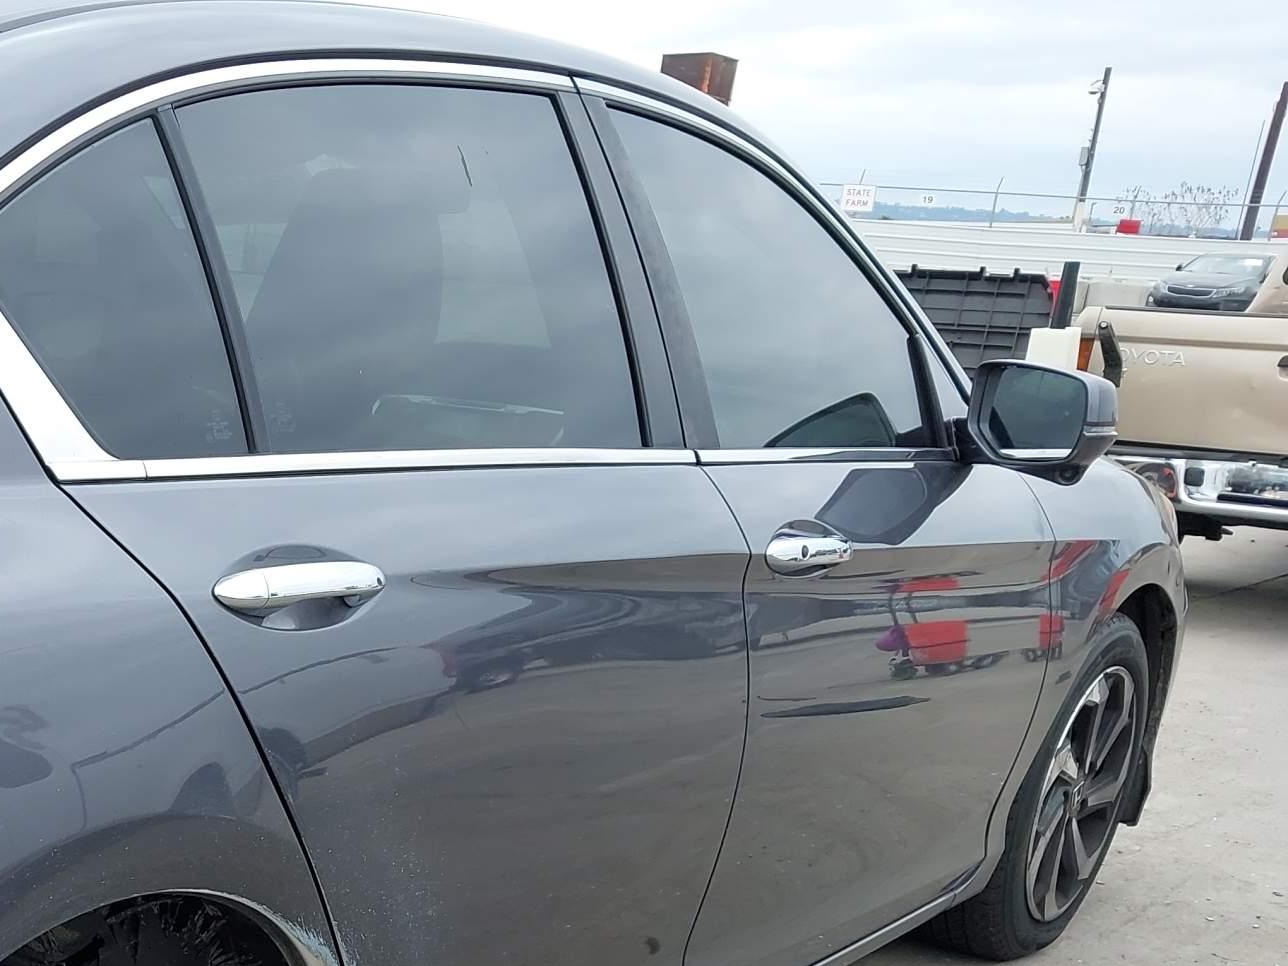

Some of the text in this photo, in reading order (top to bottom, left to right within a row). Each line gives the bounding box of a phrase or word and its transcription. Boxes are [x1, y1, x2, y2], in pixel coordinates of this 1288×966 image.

[846, 188, 871, 197] STATE
[845, 198, 869, 207] FARM
[923, 195, 934, 204] 19
[1113, 206, 1126, 214] 20
[1119, 347, 1186, 367] OYOTA
